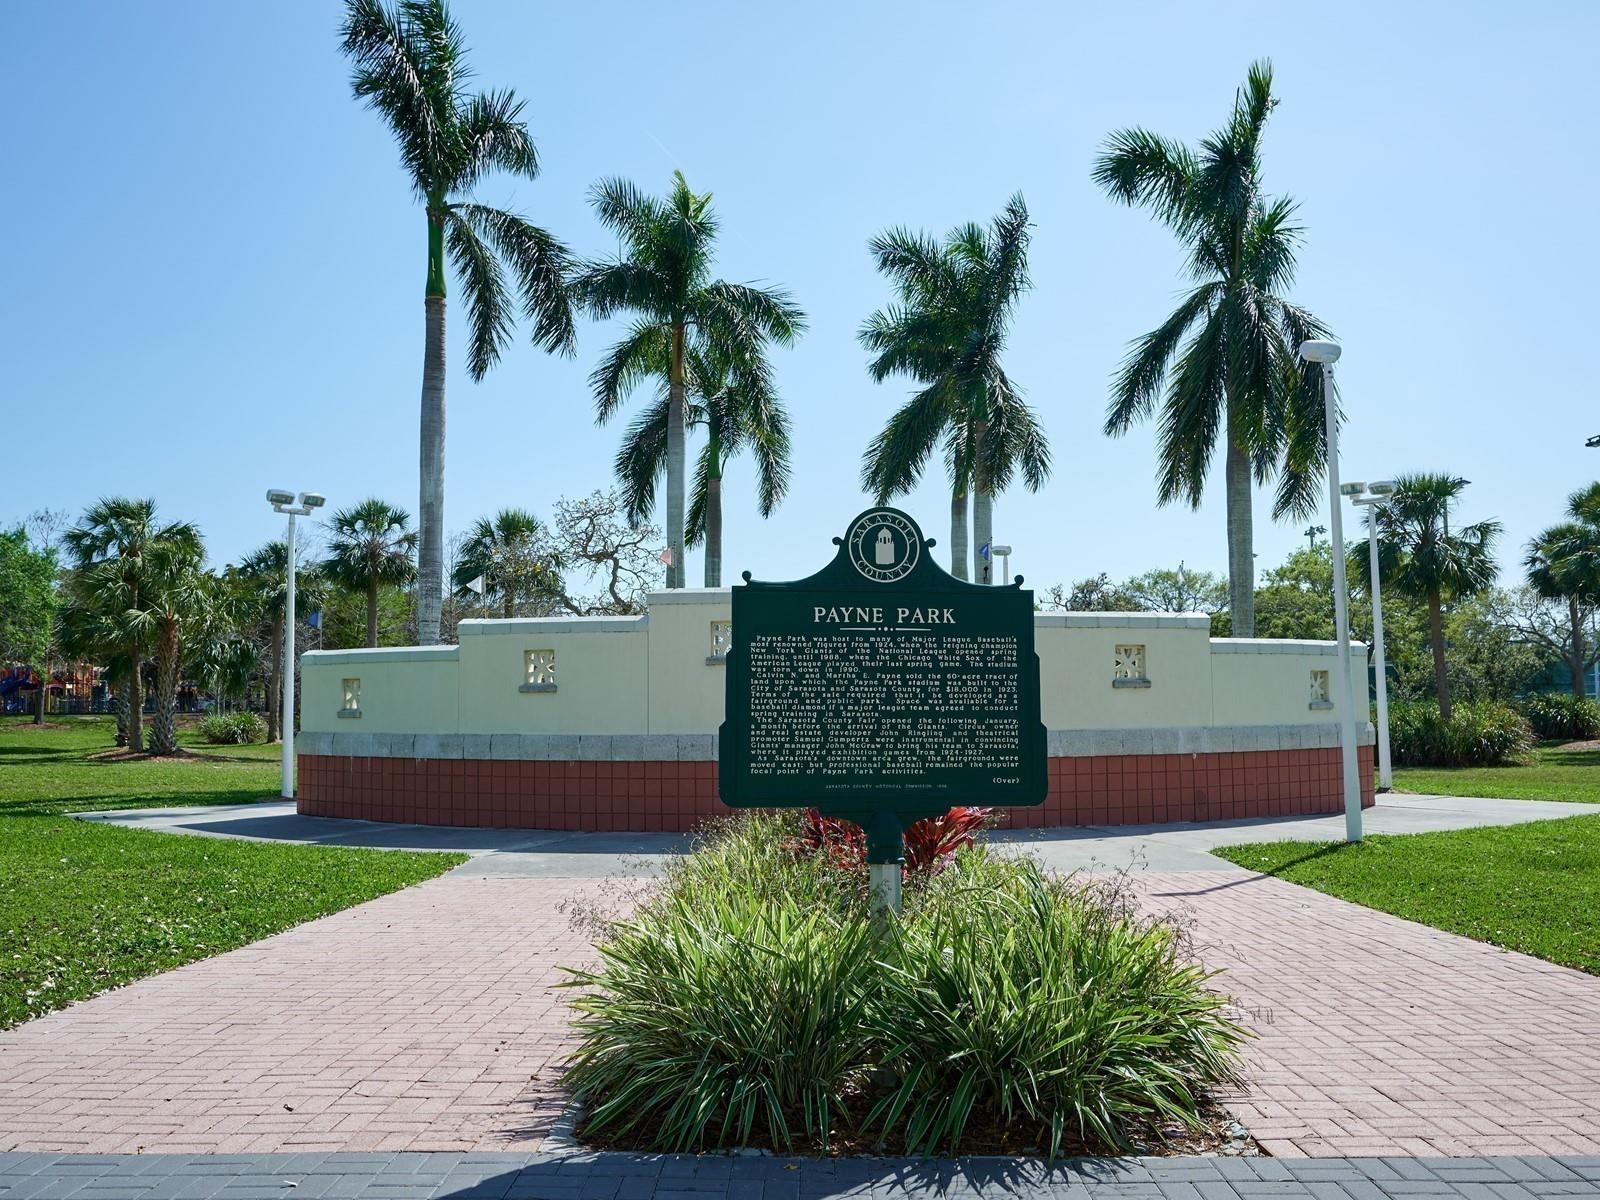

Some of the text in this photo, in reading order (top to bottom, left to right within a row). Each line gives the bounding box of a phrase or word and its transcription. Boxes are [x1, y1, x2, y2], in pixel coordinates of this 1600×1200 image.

[853, 515, 916, 544] SARASOTA
[857, 560, 912, 580] COUNTY
[813, 606, 957, 624] PAYNE PARK
